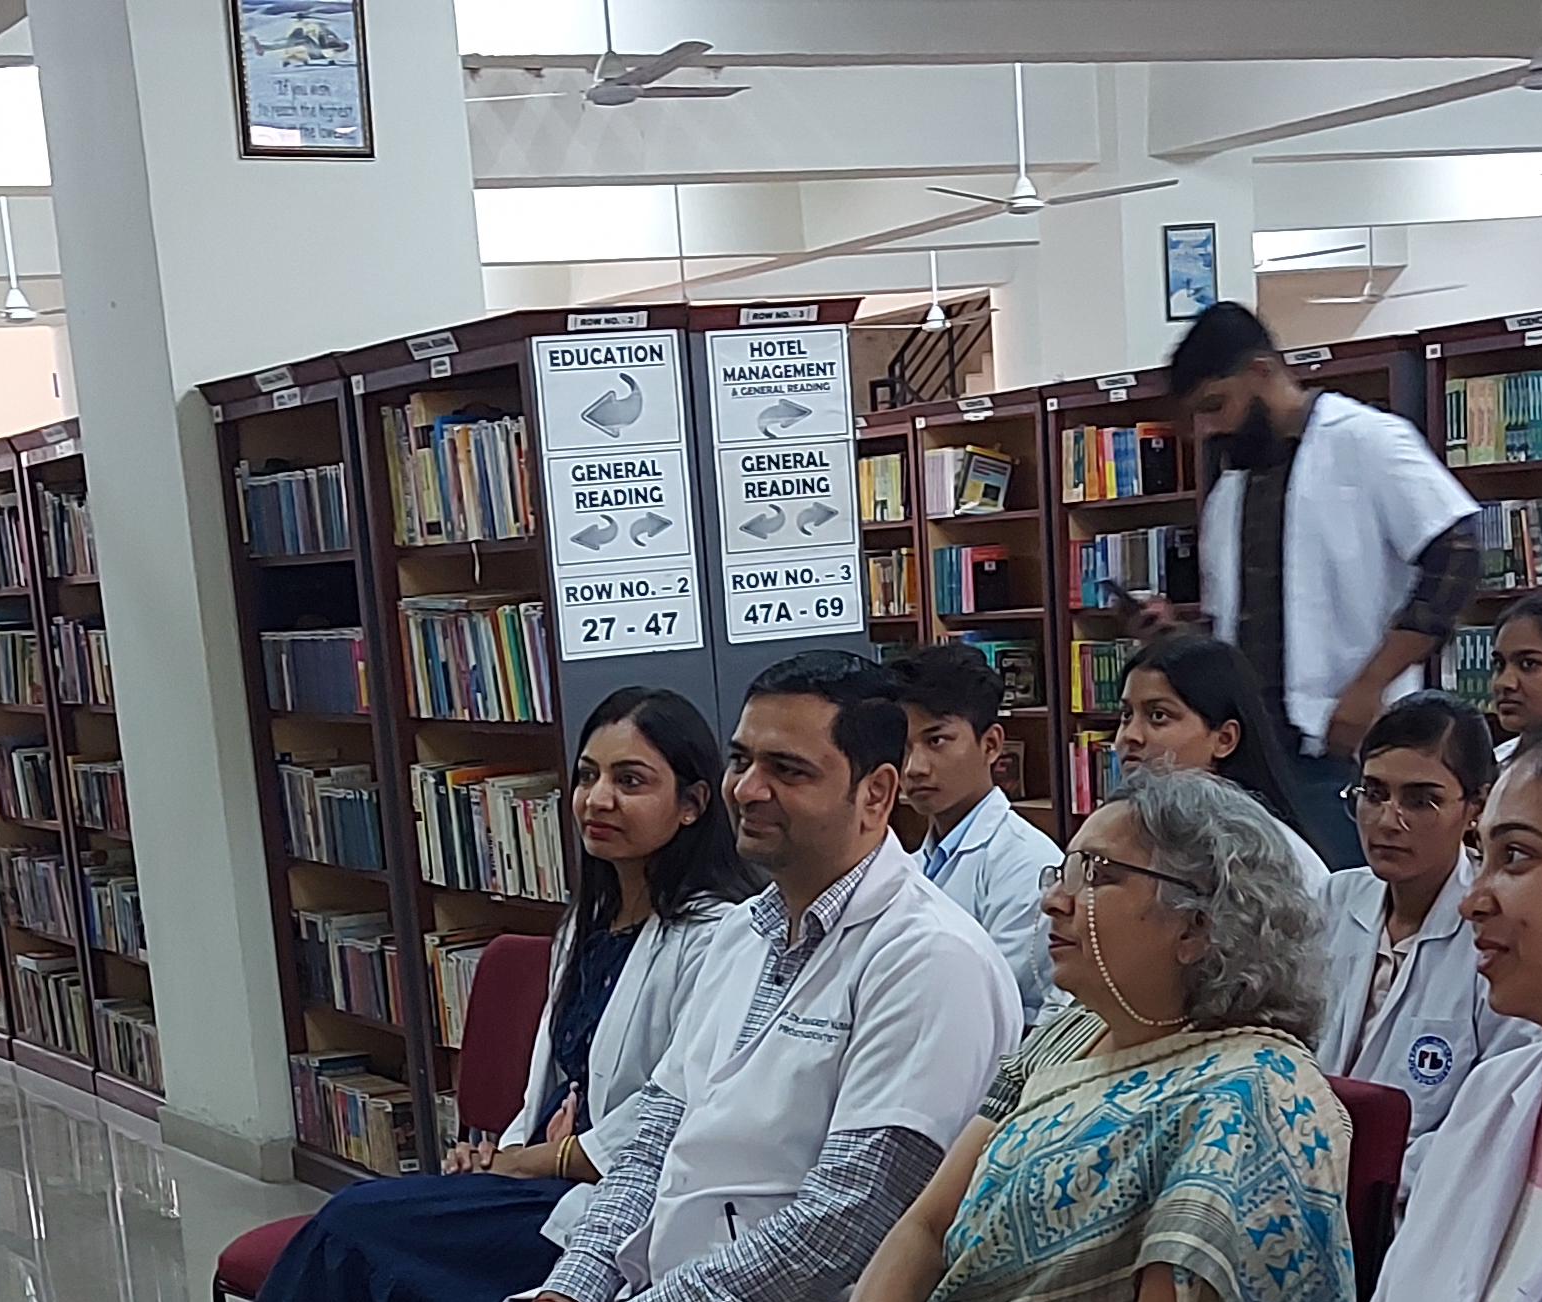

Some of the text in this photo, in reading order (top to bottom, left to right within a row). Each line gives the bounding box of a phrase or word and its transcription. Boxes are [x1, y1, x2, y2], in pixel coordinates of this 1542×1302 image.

[548, 344, 664, 367] EDUCATION
[749, 339, 807, 358] HOTEL
[722, 362, 836, 382] MANAGEMENT
[740, 384, 785, 396] GENERAL
[787, 382, 831, 393] READING
[571, 459, 663, 483] GENERAL
[741, 450, 830, 473] GENERAL
[574, 486, 664, 510] READING
[744, 477, 831, 499] READING
[731, 571, 778, 590] ROW
[785, 567, 820, 586] NO.
[840, 564, 852, 582] 3
[565, 582, 614, 603] ROW
[620, 580, 656, 599] NO.
[677, 577, 690, 595] 2
[744, 602, 793, 625] 47A
[814, 598, 844, 618] 69
[581, 617, 617, 643] 27
[644, 611, 679, 636] 47
